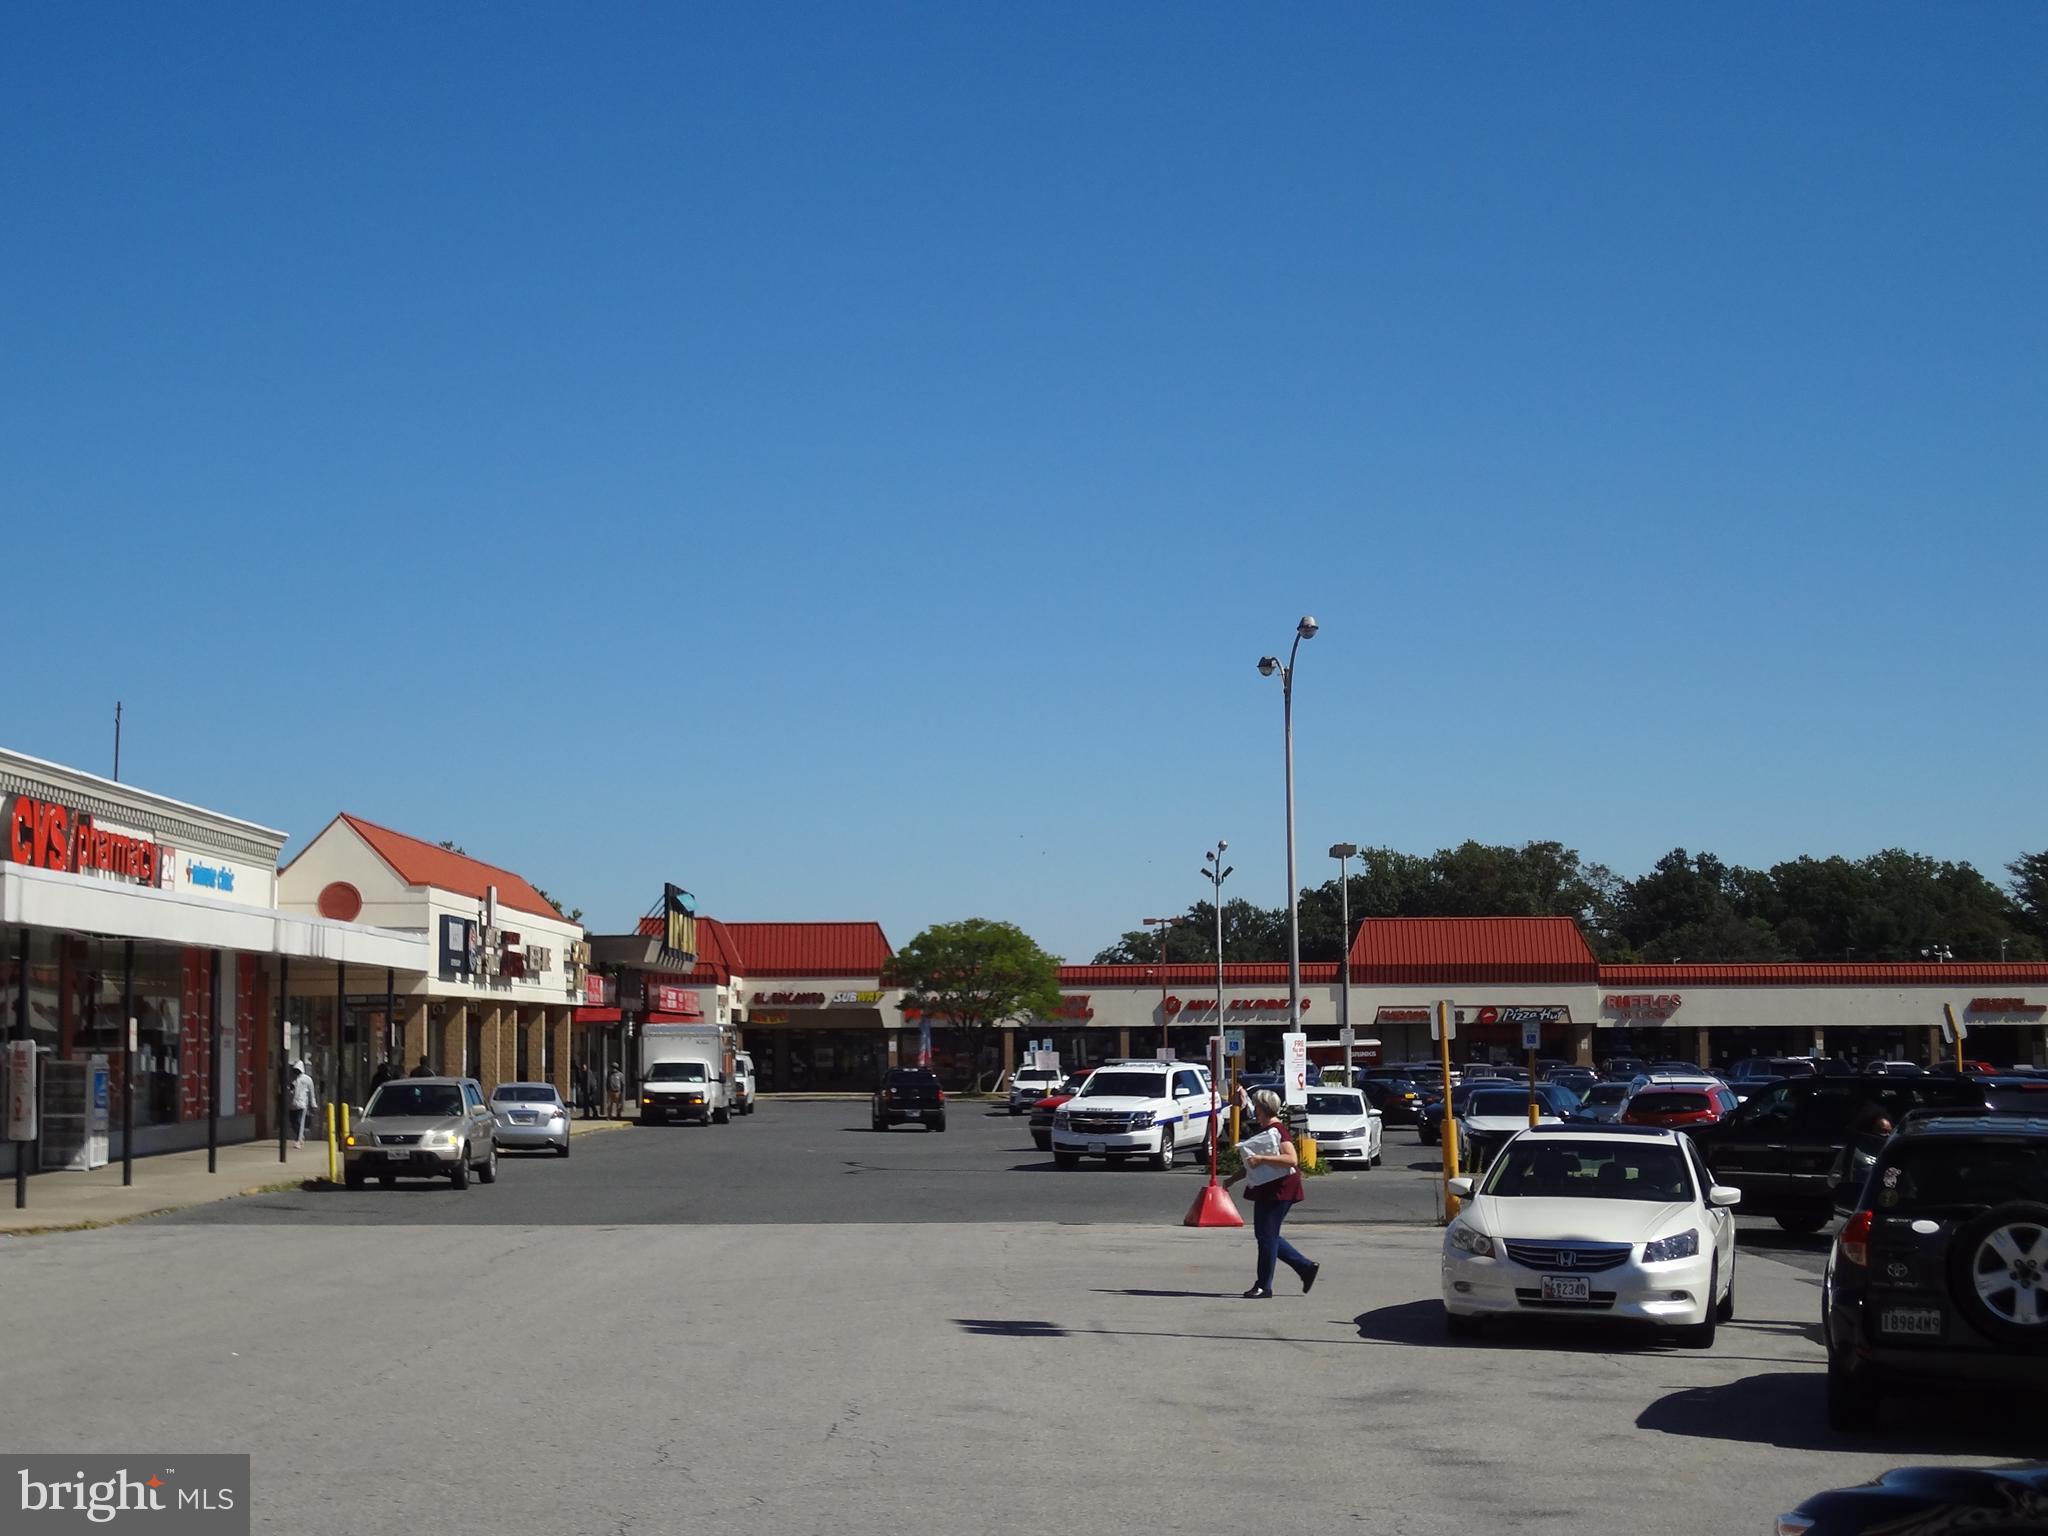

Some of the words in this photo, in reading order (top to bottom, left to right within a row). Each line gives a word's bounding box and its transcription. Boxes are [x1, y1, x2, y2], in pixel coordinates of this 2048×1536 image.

[833, 991, 886, 1003] SUBWAY
[1229, 997, 1312, 1010] EXPRES
[1503, 1008, 1538, 1021] Pizza
[1539, 1008, 1563, 1020] Hut
